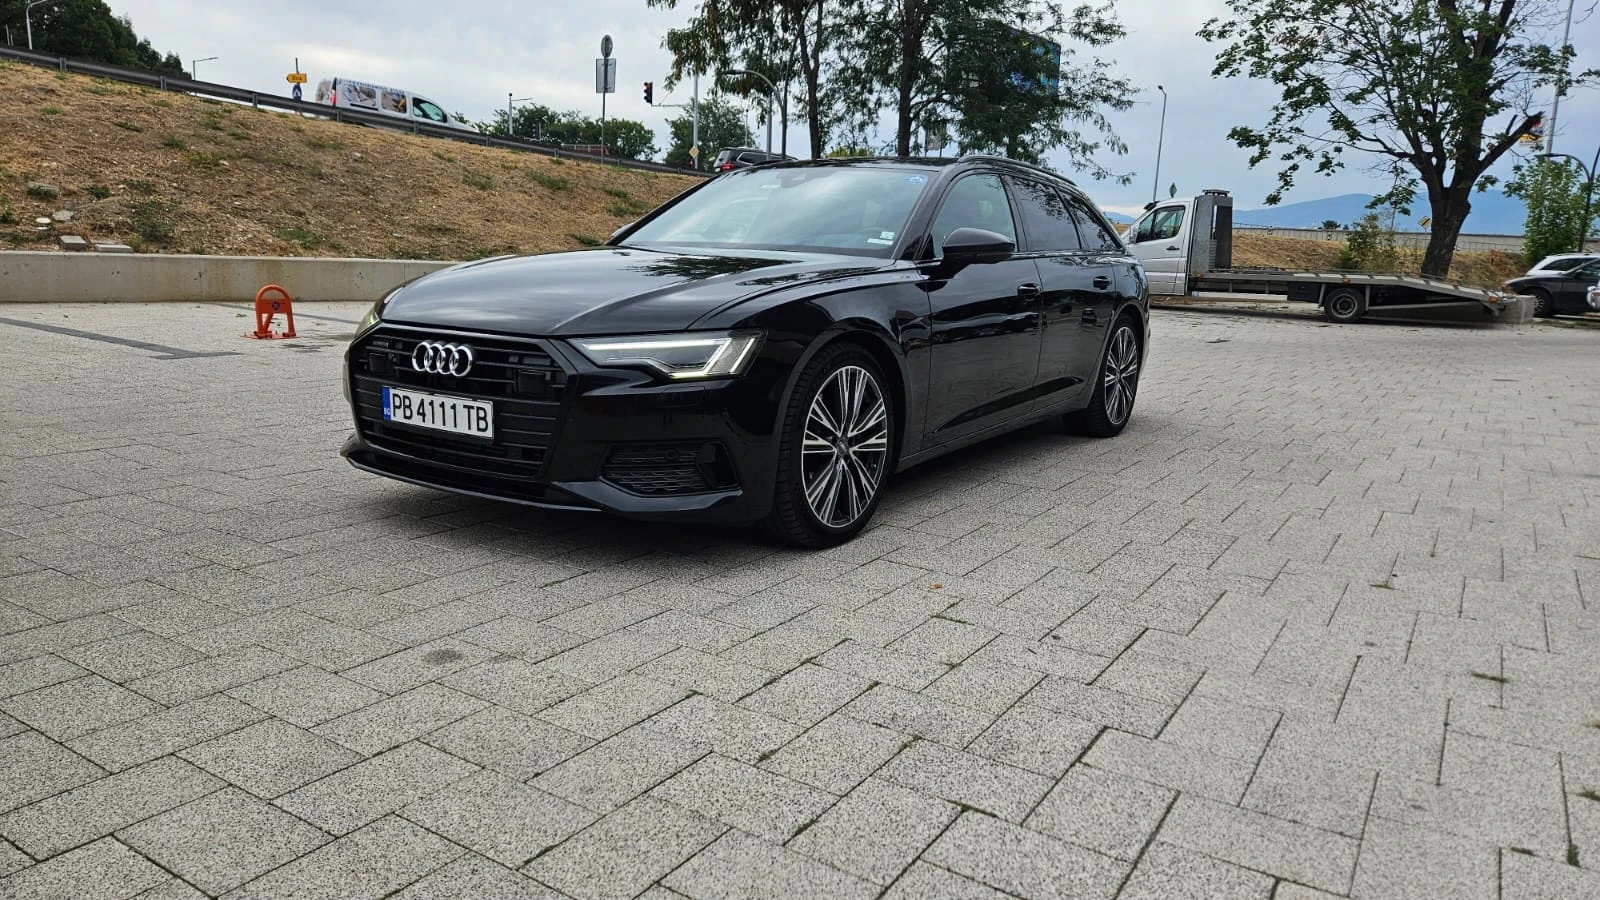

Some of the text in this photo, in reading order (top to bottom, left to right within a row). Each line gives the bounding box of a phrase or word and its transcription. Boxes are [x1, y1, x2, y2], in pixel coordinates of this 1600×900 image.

[392, 393, 489, 432] PB 4111 TB
